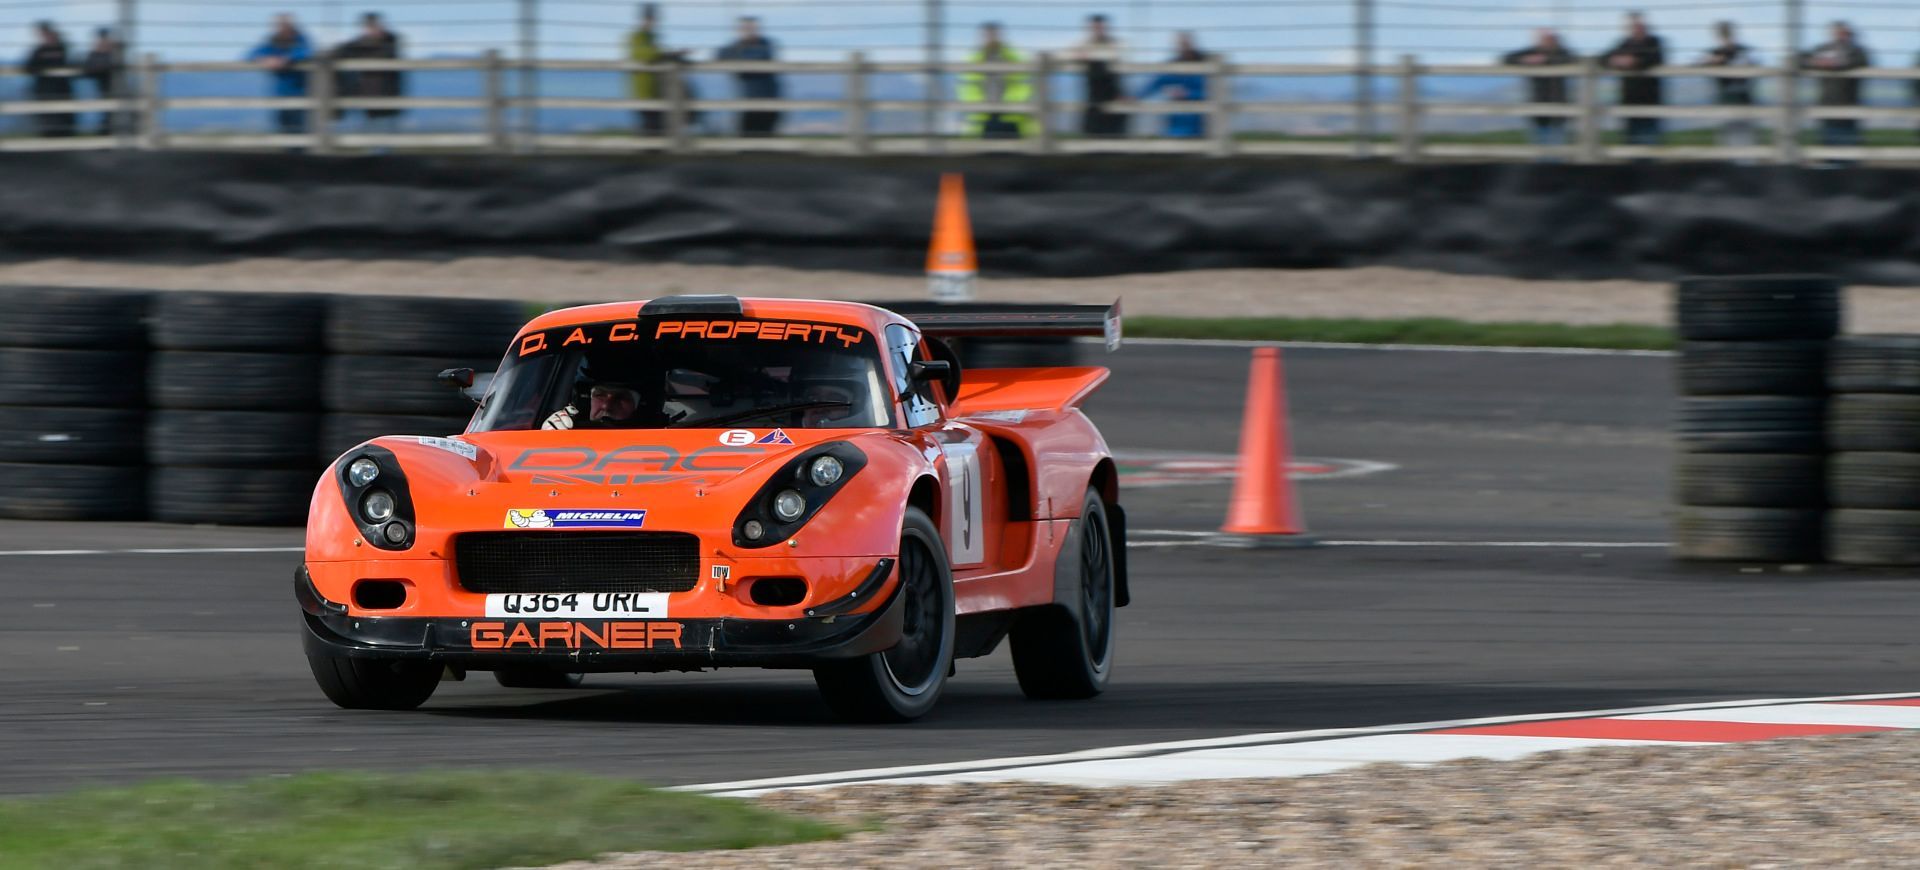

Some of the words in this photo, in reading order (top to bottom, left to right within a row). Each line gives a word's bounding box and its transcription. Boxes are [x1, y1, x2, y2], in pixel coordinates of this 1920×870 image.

[519, 333, 547, 357] D.
[562, 327, 593, 346] A.
[609, 323, 639, 342] C.
[655, 320, 863, 348] PROPERTY
[727, 432, 747, 443] E
[508, 445, 765, 472] DAC
[962, 456, 971, 550] 9
[555, 512, 644, 520] MICHELIN
[713, 566, 729, 578] TOW
[503, 593, 578, 613] Q364
[592, 593, 649, 613] URL
[471, 622, 682, 649] GARNER
